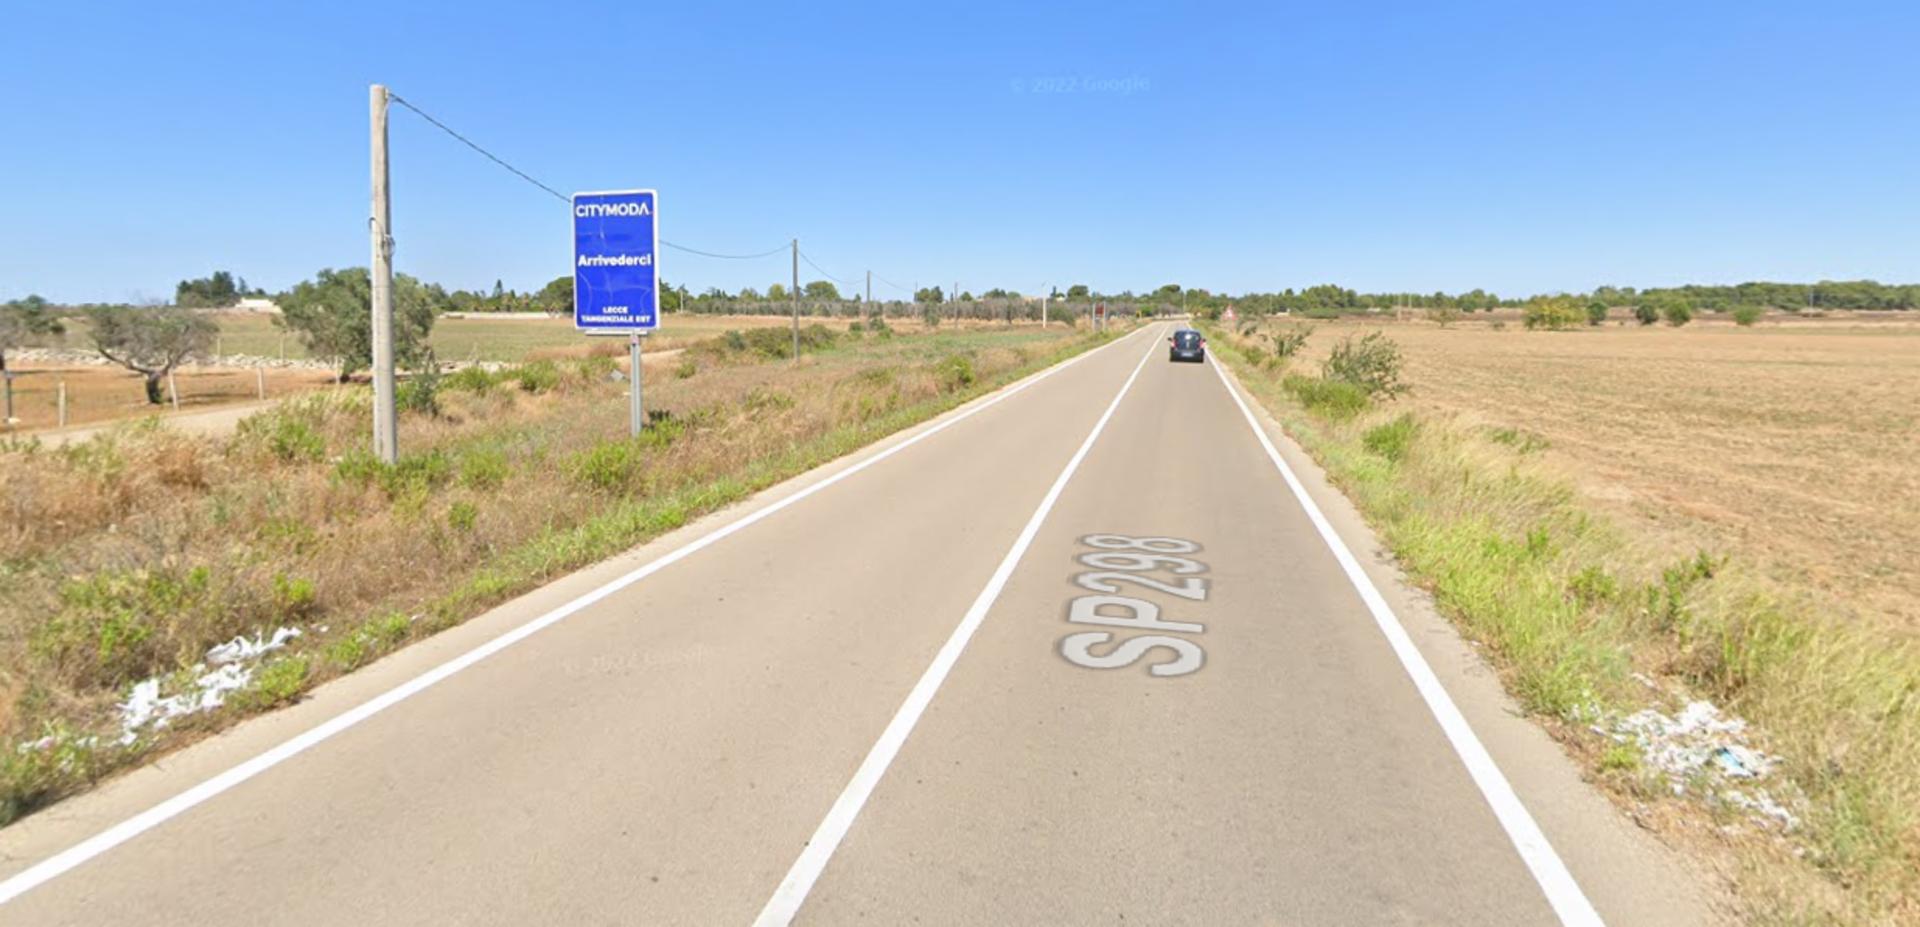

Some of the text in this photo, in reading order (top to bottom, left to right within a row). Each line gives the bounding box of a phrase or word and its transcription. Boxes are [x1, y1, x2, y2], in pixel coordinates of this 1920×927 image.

[576, 203, 650, 217] CITYMODA
[578, 254, 651, 267] Arrivederci
[602, 306, 628, 314] LECCE
[581, 315, 651, 323] TANGENZIALE EST
